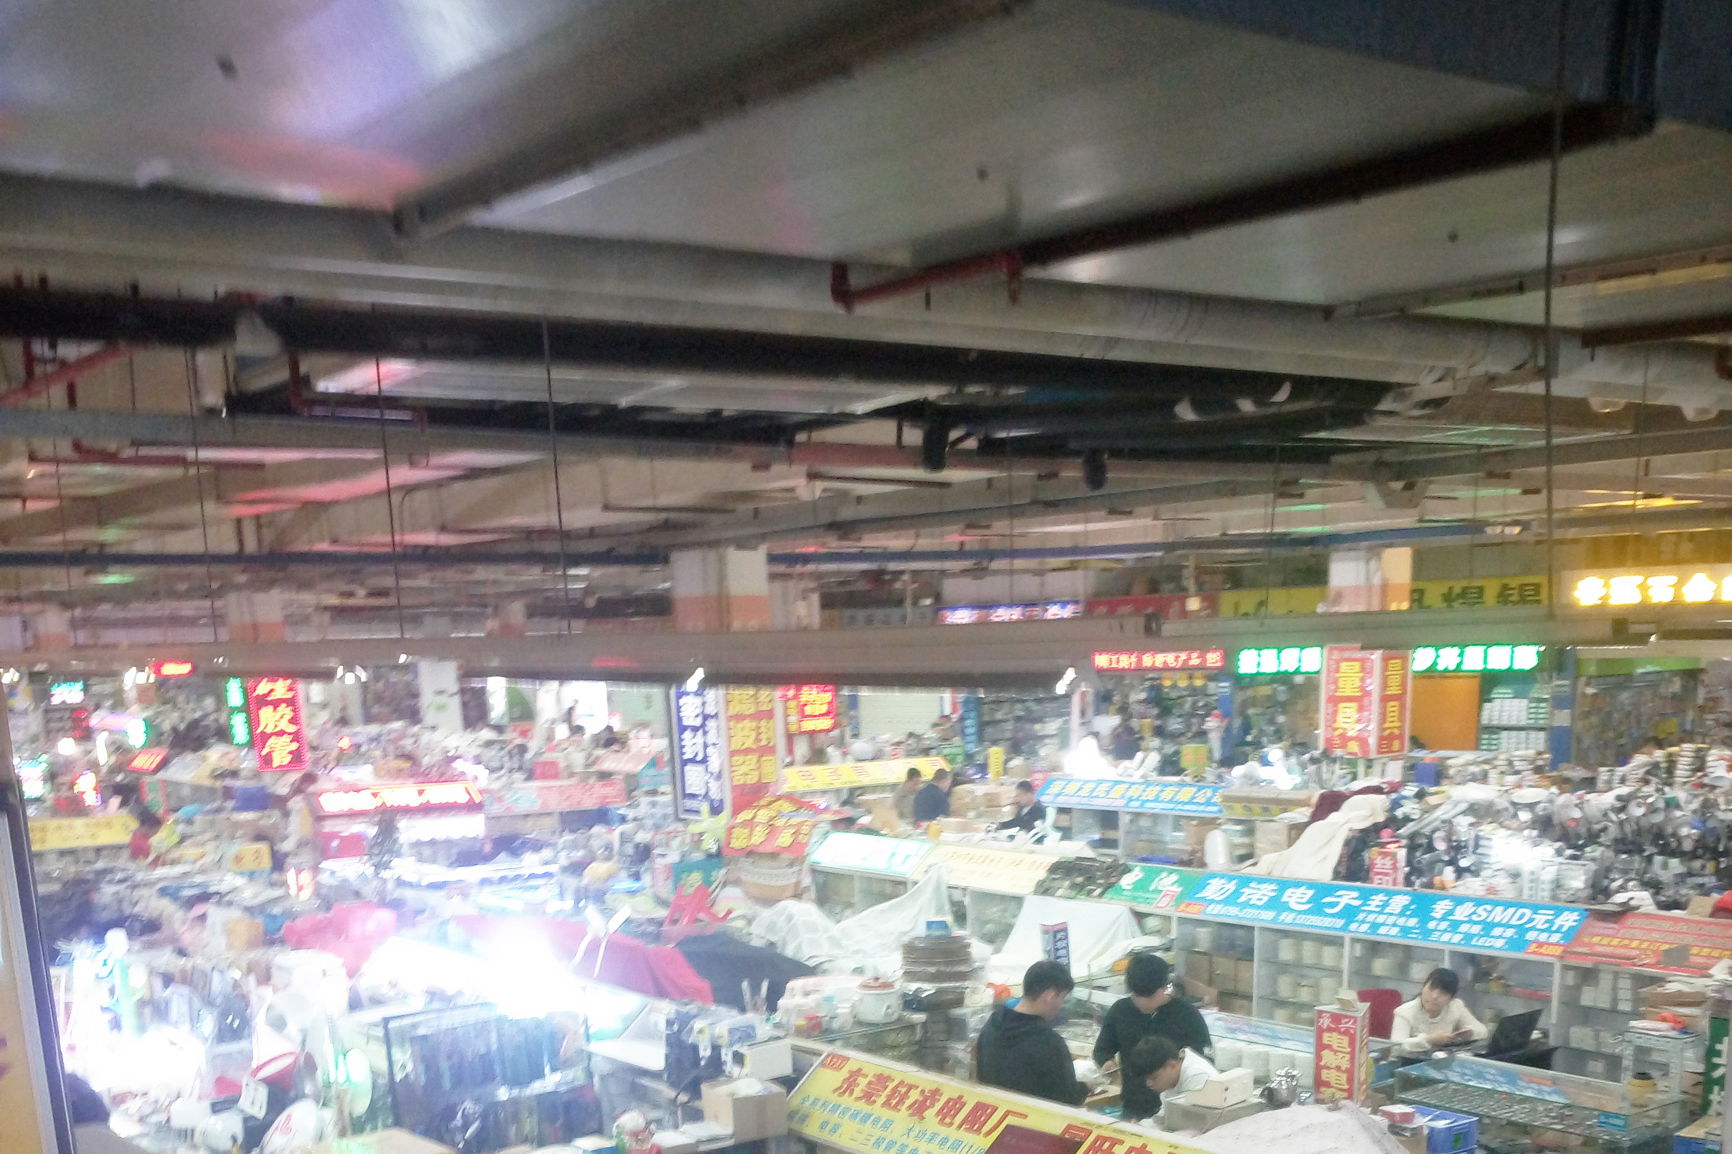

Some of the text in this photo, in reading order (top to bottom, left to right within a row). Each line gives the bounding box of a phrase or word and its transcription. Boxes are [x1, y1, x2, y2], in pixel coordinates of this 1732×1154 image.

[1195, 877, 1363, 914] 勤诺电子
[1431, 900, 1580, 932] 专业SMD元件
